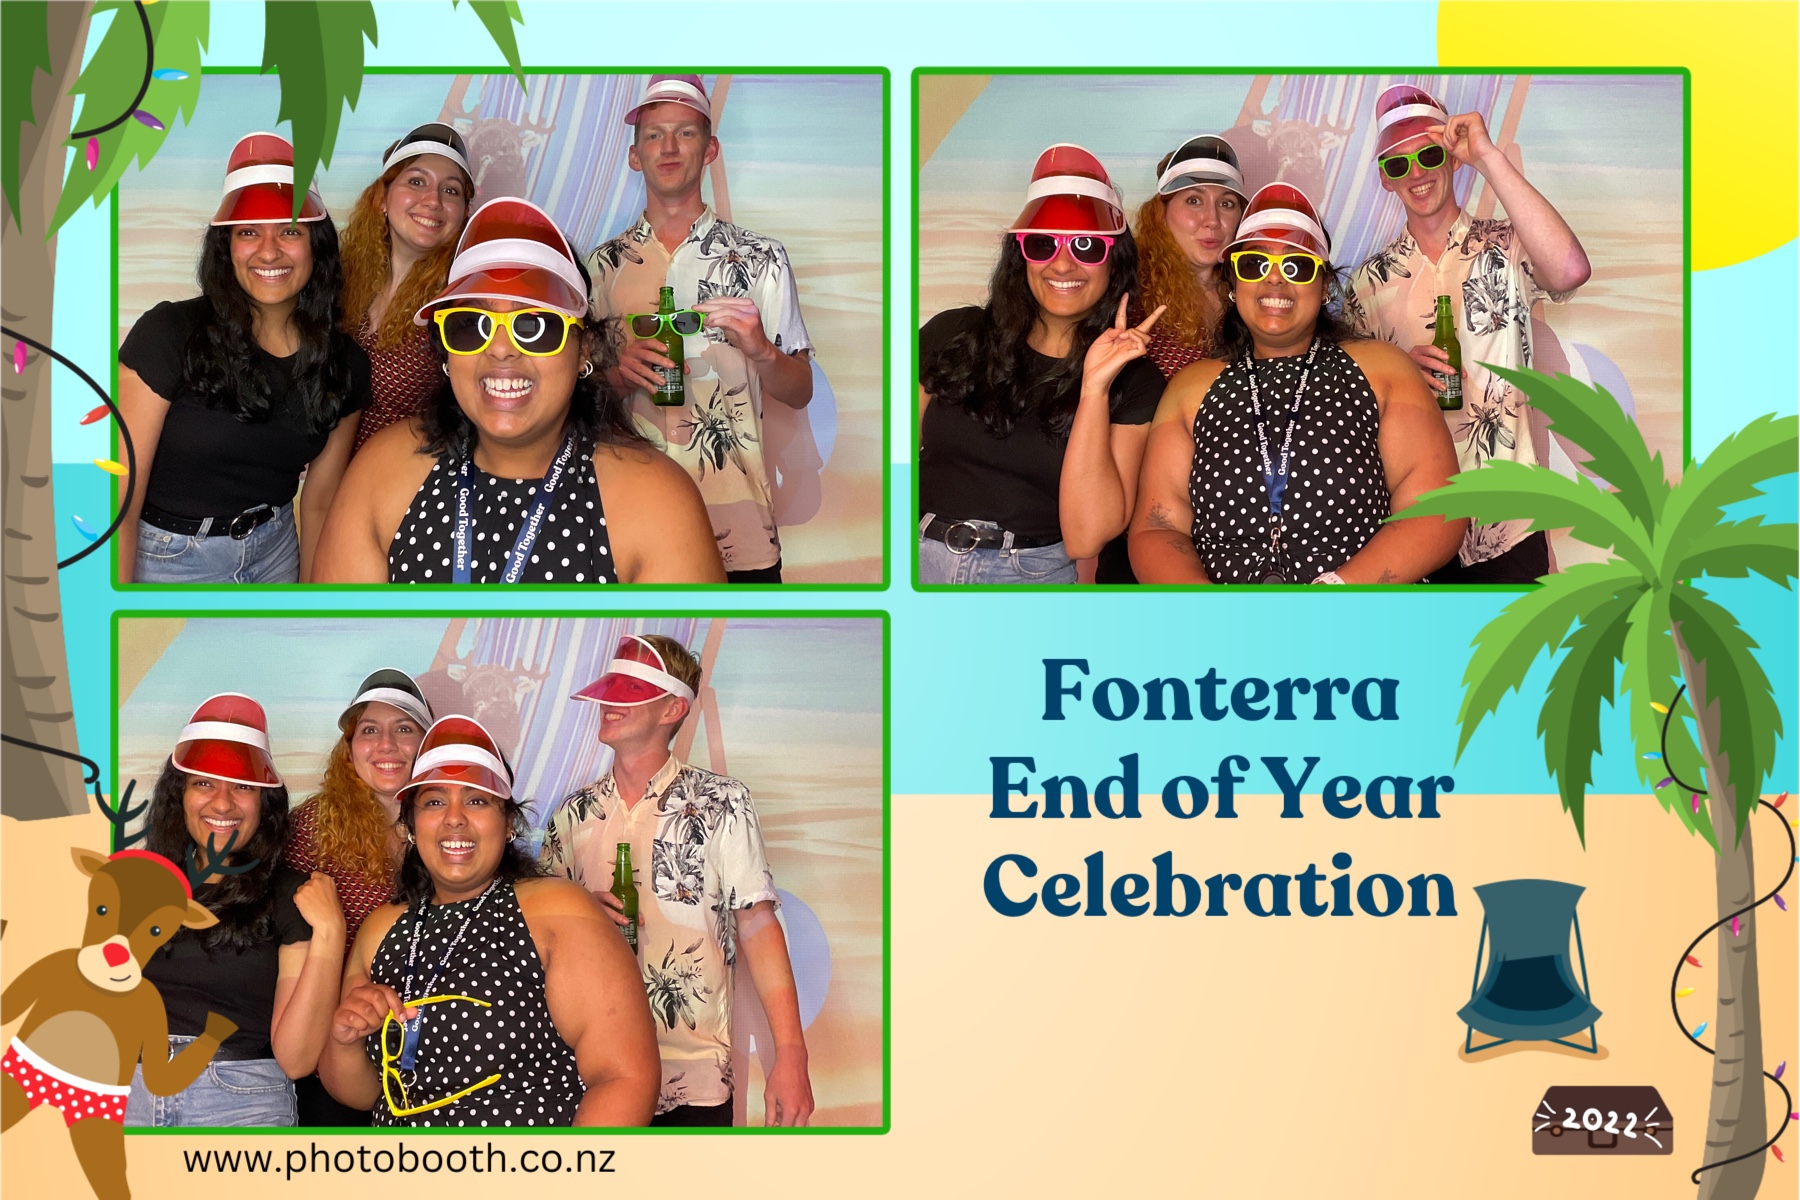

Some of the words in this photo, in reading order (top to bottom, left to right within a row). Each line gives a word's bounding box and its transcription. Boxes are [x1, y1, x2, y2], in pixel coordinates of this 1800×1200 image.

[1248, 374, 1258, 390] Good
[1296, 368, 1310, 395] Together
[1250, 388, 1262, 416] Together
[1291, 394, 1302, 413] Good
[1257, 422, 1268, 441] Good
[1281, 420, 1296, 452] Together
[1260, 438, 1272, 476] Together
[1278, 452, 1288, 476] Good
[544, 466, 562, 493] Good
[458, 488, 470, 517] Good
[456, 518, 468, 571] Together
[505, 550, 525, 584] Good
[517, 502, 546, 552] Together
[472, 895, 486, 912] Good
[414, 920, 422, 938] Good
[440, 945, 454, 966] Good
[449, 917, 472, 946] Together
[408, 936, 420, 966] Together
[404, 974, 414, 995] Good
